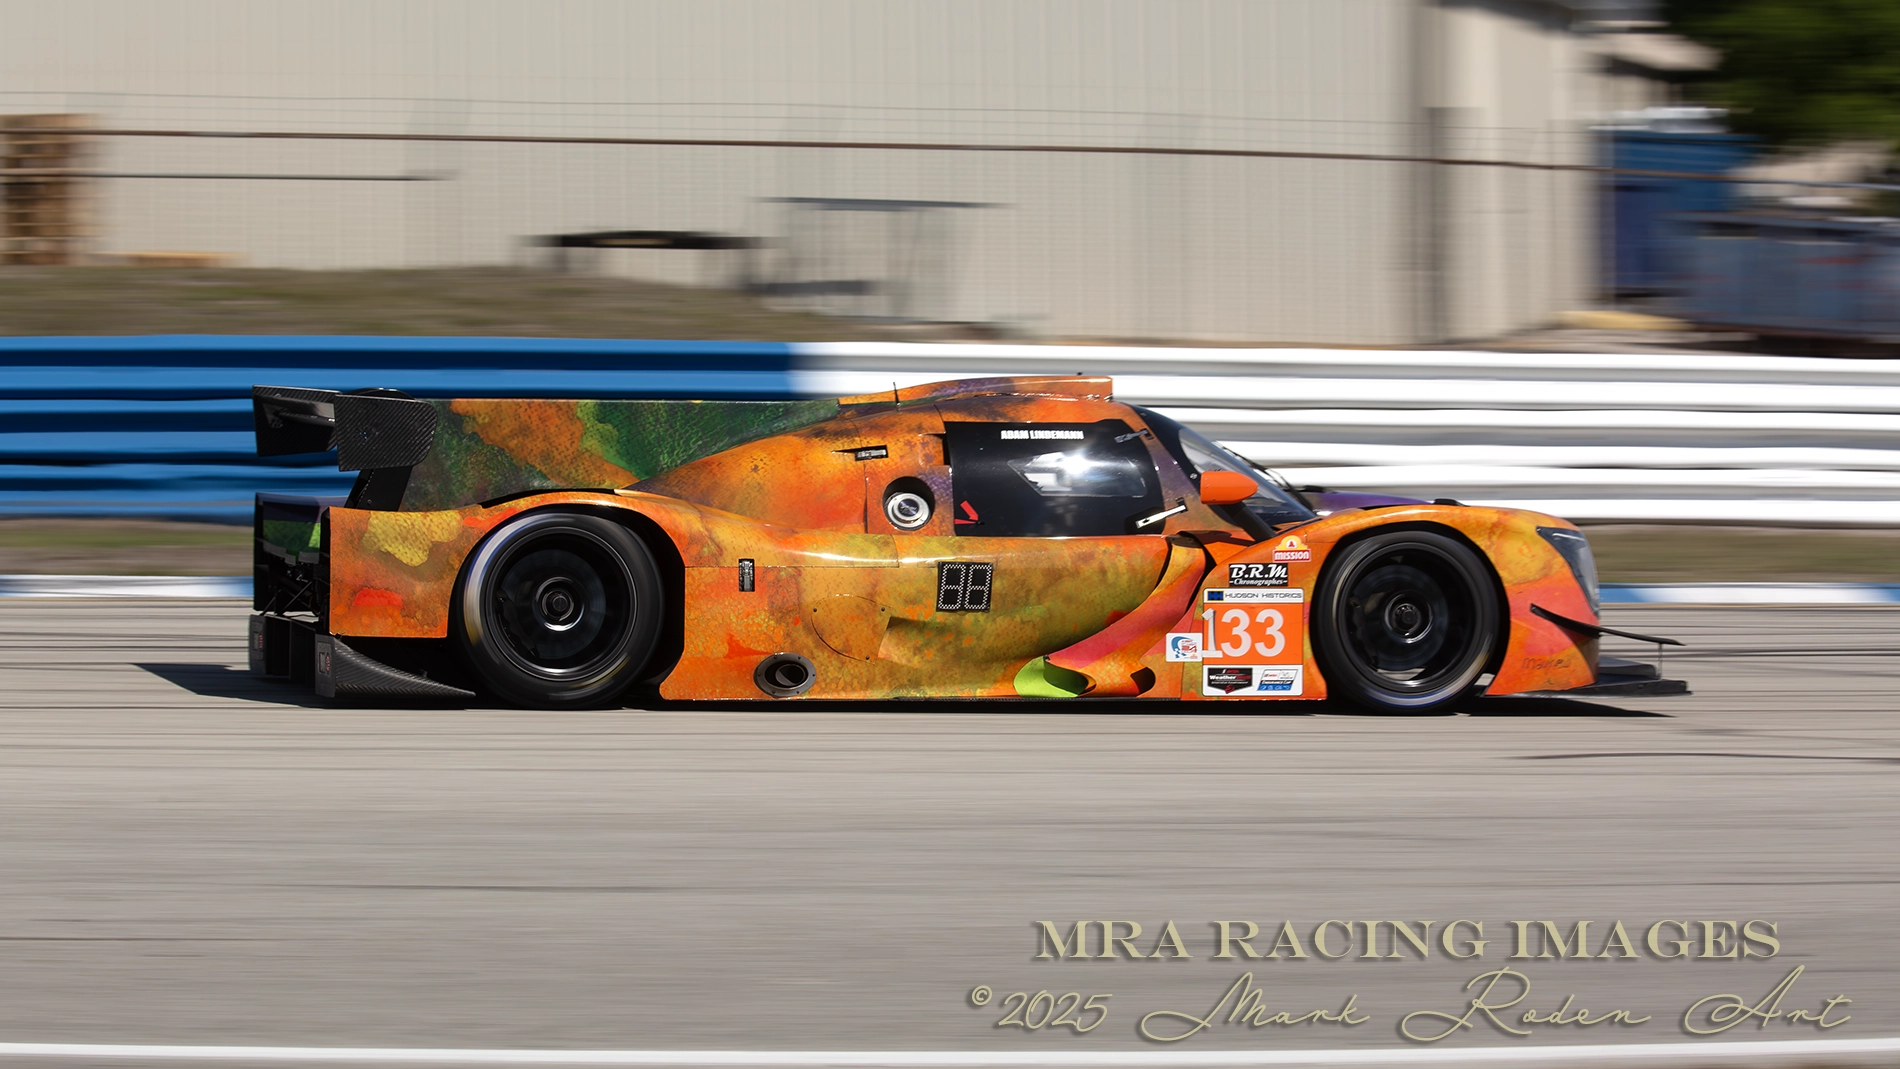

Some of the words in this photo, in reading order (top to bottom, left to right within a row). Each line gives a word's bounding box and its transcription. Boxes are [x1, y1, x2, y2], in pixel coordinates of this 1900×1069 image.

[1001, 430, 1029, 440] ADAM
[1029, 430, 1084, 440] LINDEMANN
[1274, 551, 1310, 560] MISSION
[1229, 563, 1288, 578] B.R.M
[1202, 608, 1286, 658] 133
